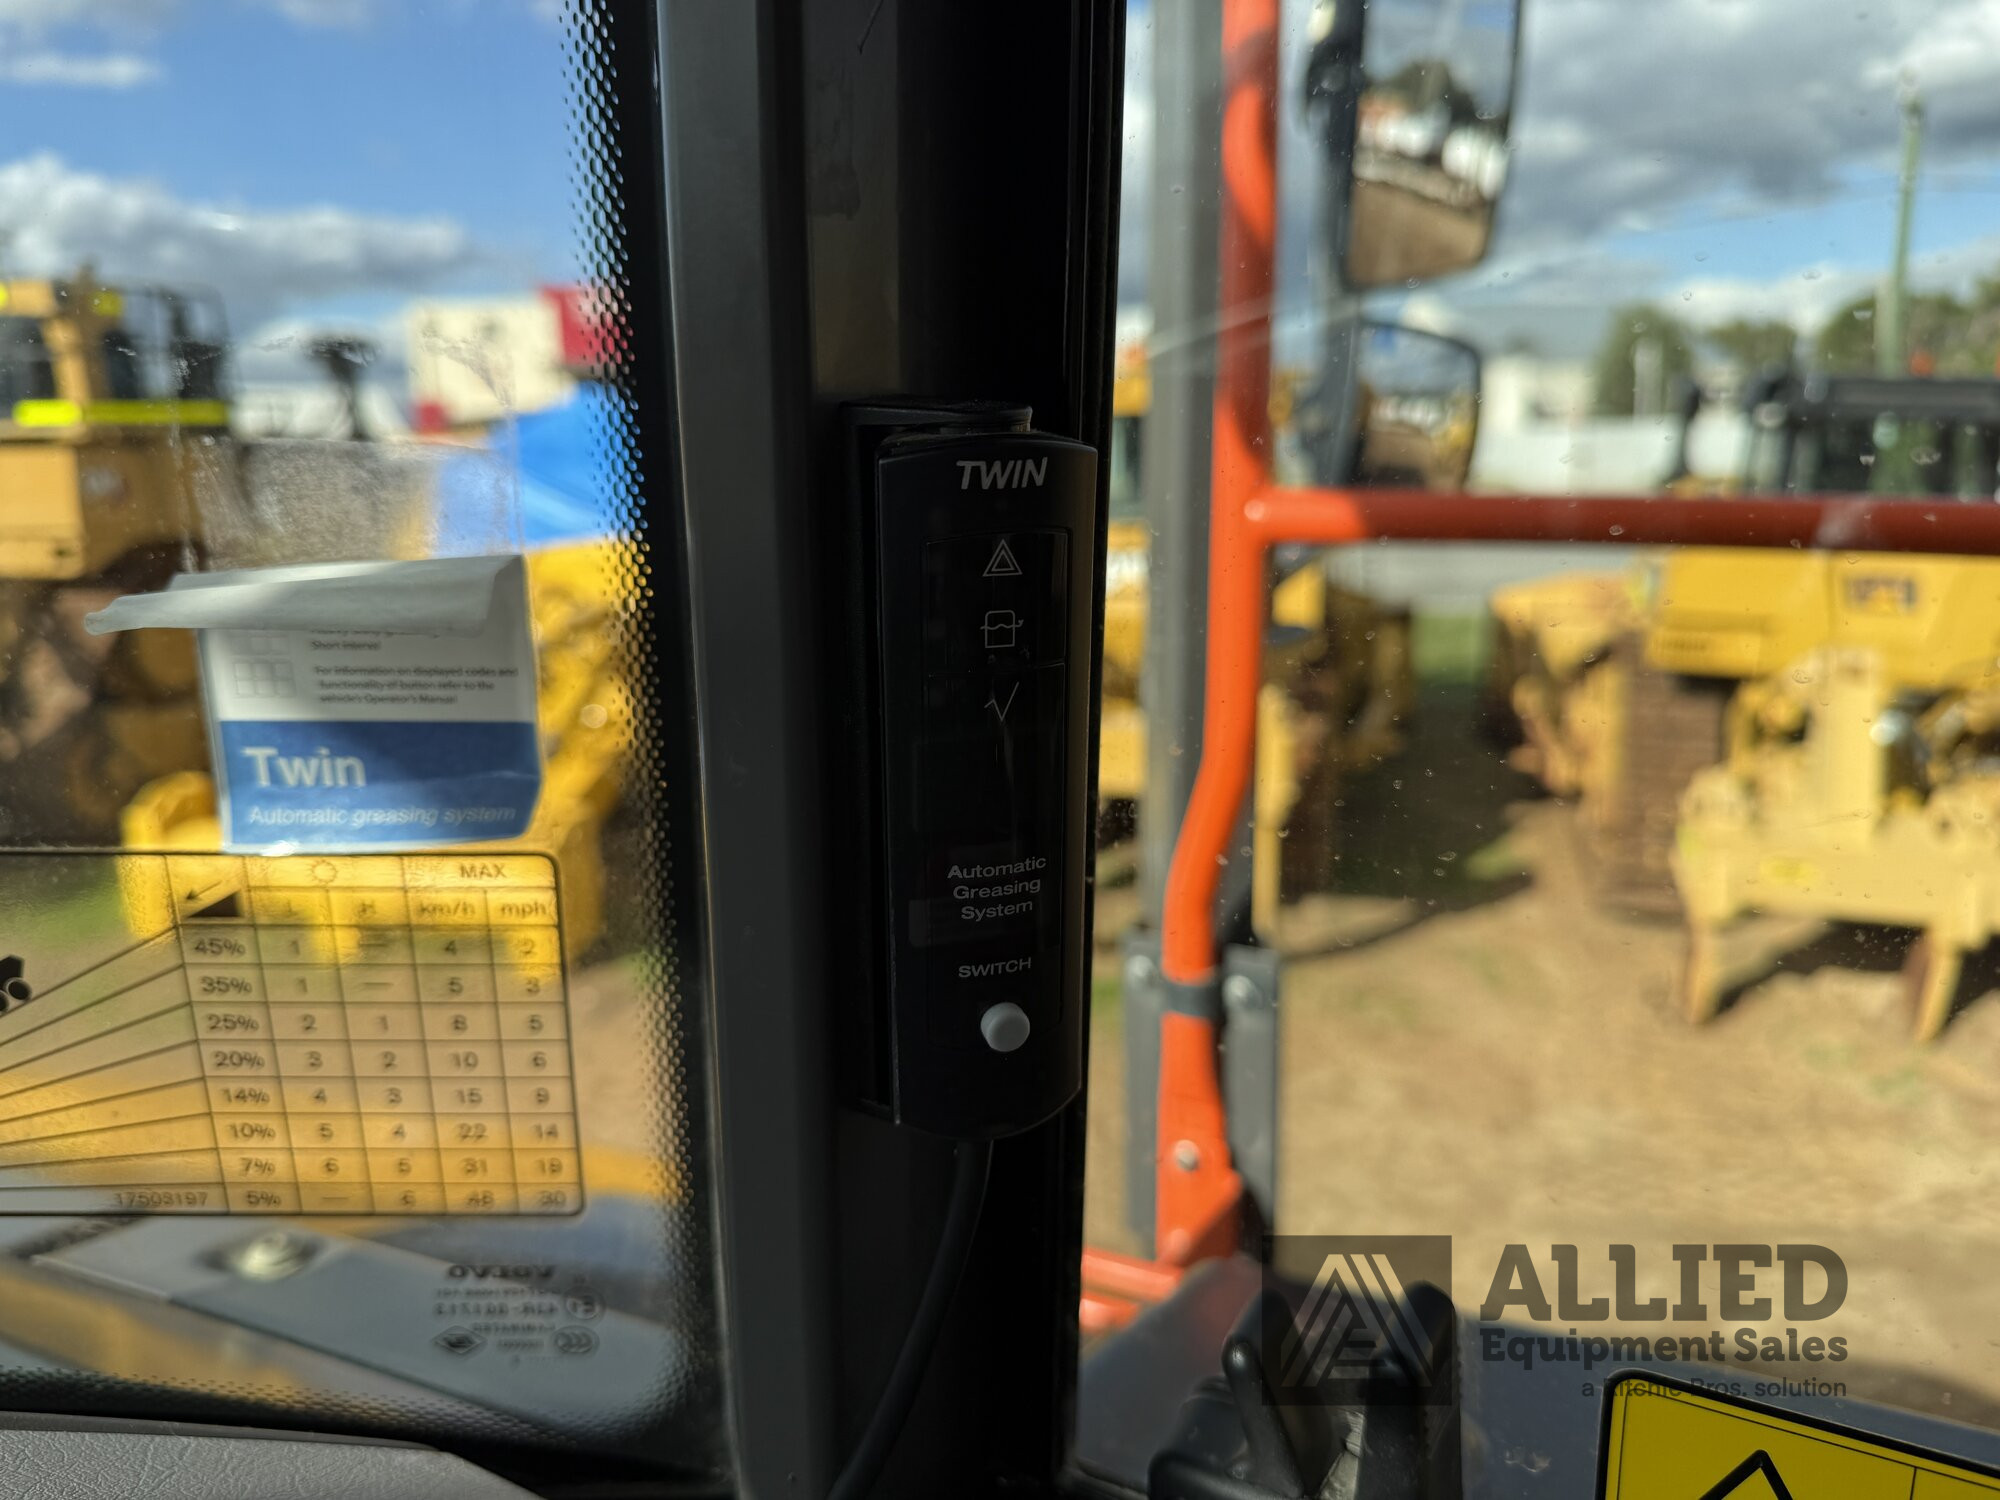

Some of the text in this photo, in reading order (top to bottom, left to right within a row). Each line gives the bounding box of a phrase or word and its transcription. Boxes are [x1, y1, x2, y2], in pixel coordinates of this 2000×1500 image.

[956, 456, 1048, 490] TWIN
[241, 746, 367, 789] Twin
[250, 805, 517, 829] Automatic greasing system
[459, 863, 508, 879] MAX
[947, 856, 1047, 879] Automatic
[953, 878, 1041, 900] Greasing
[419, 900, 476, 918] km/h
[500, 900, 548, 919] mph
[960, 900, 1033, 922] System
[194, 937, 246, 956] 45%
[444, 939, 457, 956] 4
[958, 957, 1032, 978] SWITCH
[201, 975, 253, 995] 35%
[447, 976, 464, 995] 5
[207, 1013, 260, 1033] 25%
[302, 1013, 317, 1032] 2
[214, 1050, 266, 1070] 20%
[383, 1050, 398, 1070] 2
[452, 1050, 479, 1071] 10
[221, 1086, 271, 1105] 14%
[314, 1087, 328, 1105] 4
[229, 1122, 277, 1140] 10%
[392, 1123, 406, 1141] 4
[456, 1122, 488, 1142] 22
[534, 1122, 559, 1141] 14
[239, 1156, 276, 1176] 7%
[245, 1189, 282, 1207] 5%
